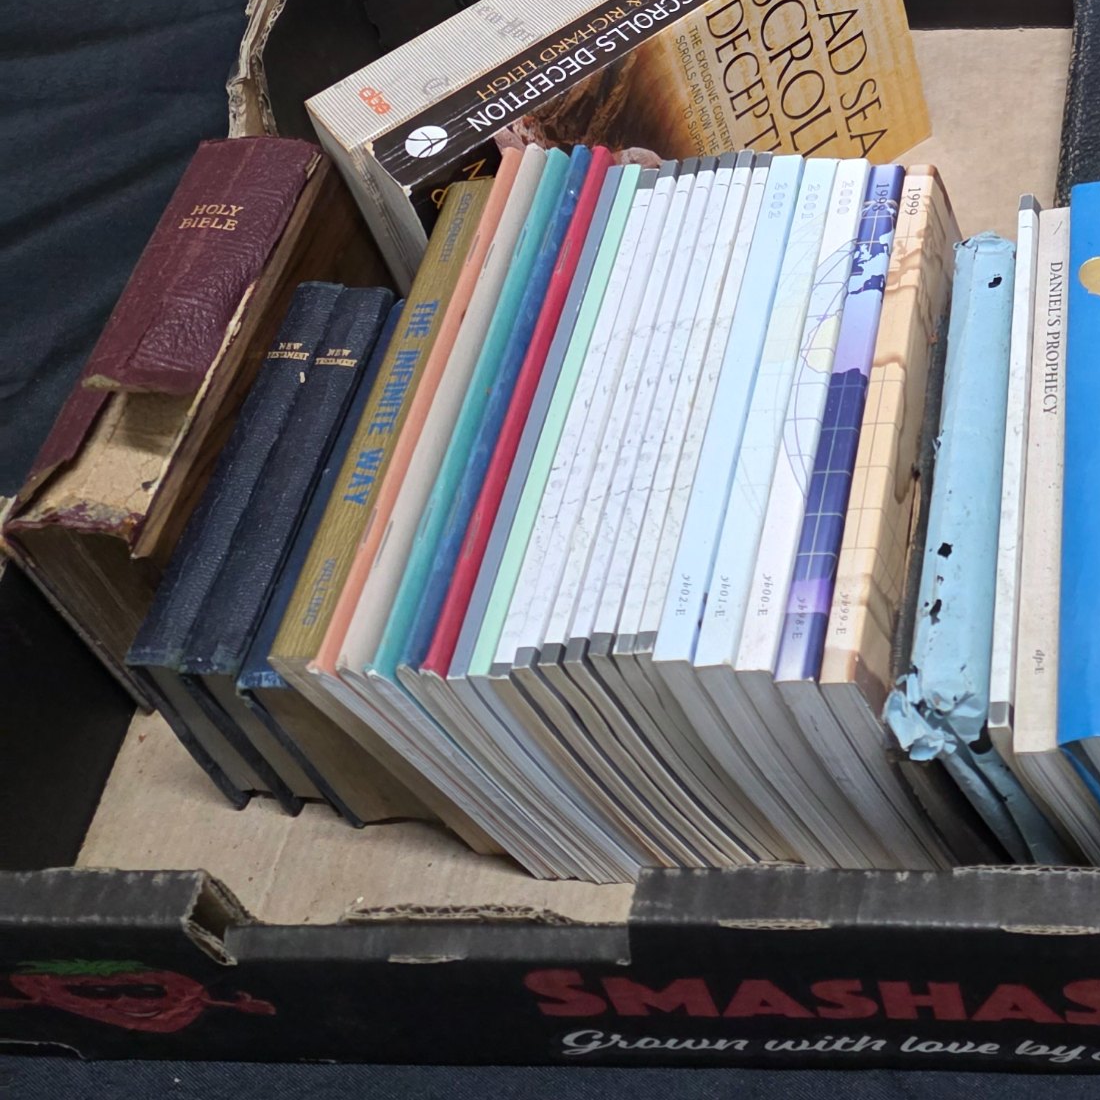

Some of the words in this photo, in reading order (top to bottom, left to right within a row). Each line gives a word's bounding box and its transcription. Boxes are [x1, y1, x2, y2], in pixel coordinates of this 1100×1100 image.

[540, 6, 628, 64] RICHARD
[476, 59, 538, 102] LEIGH
[688, 24, 700, 44] THE
[695, 44, 719, 102] EXPLOSIVE
[466, 47, 597, 133] DECEPTION
[676, 35, 693, 81] SCROLLS
[690, 82, 703, 105] AND
[698, 104, 712, 131] HOW
[708, 130, 720, 154] THE
[682, 104, 693, 119] TO
[840, 78, 890, 159] SEA
[190, 204, 244, 216] HOLY
[768, 182, 789, 220] 2002
[801, 183, 821, 220] 2001
[836, 180, 855, 215] 2000
[873, 183, 890, 212] 1998
[904, 187, 922, 216] 1999
[178, 217, 238, 231] BIBLE
[1047, 261, 1063, 327] DANIEL'S
[403, 299, 440, 340] THE
[267, 351, 310, 361] TESTAMENT
[278, 342, 303, 351] NEW
[326, 348, 352, 357] NEW
[368, 347, 423, 437] INFINITE
[1043, 330, 1061, 415] PROPHECY
[343, 448, 385, 506] WAY
[675, 573, 693, 617] yb02-E
[714, 575, 732, 618] yb01-E
[757, 573, 774, 617] yb00-E
[562, 1029, 747, 1056] Grown
[764, 1033, 887, 1054] with
[901, 1035, 1001, 1056] love
[1014, 1038, 1086, 1064] by
